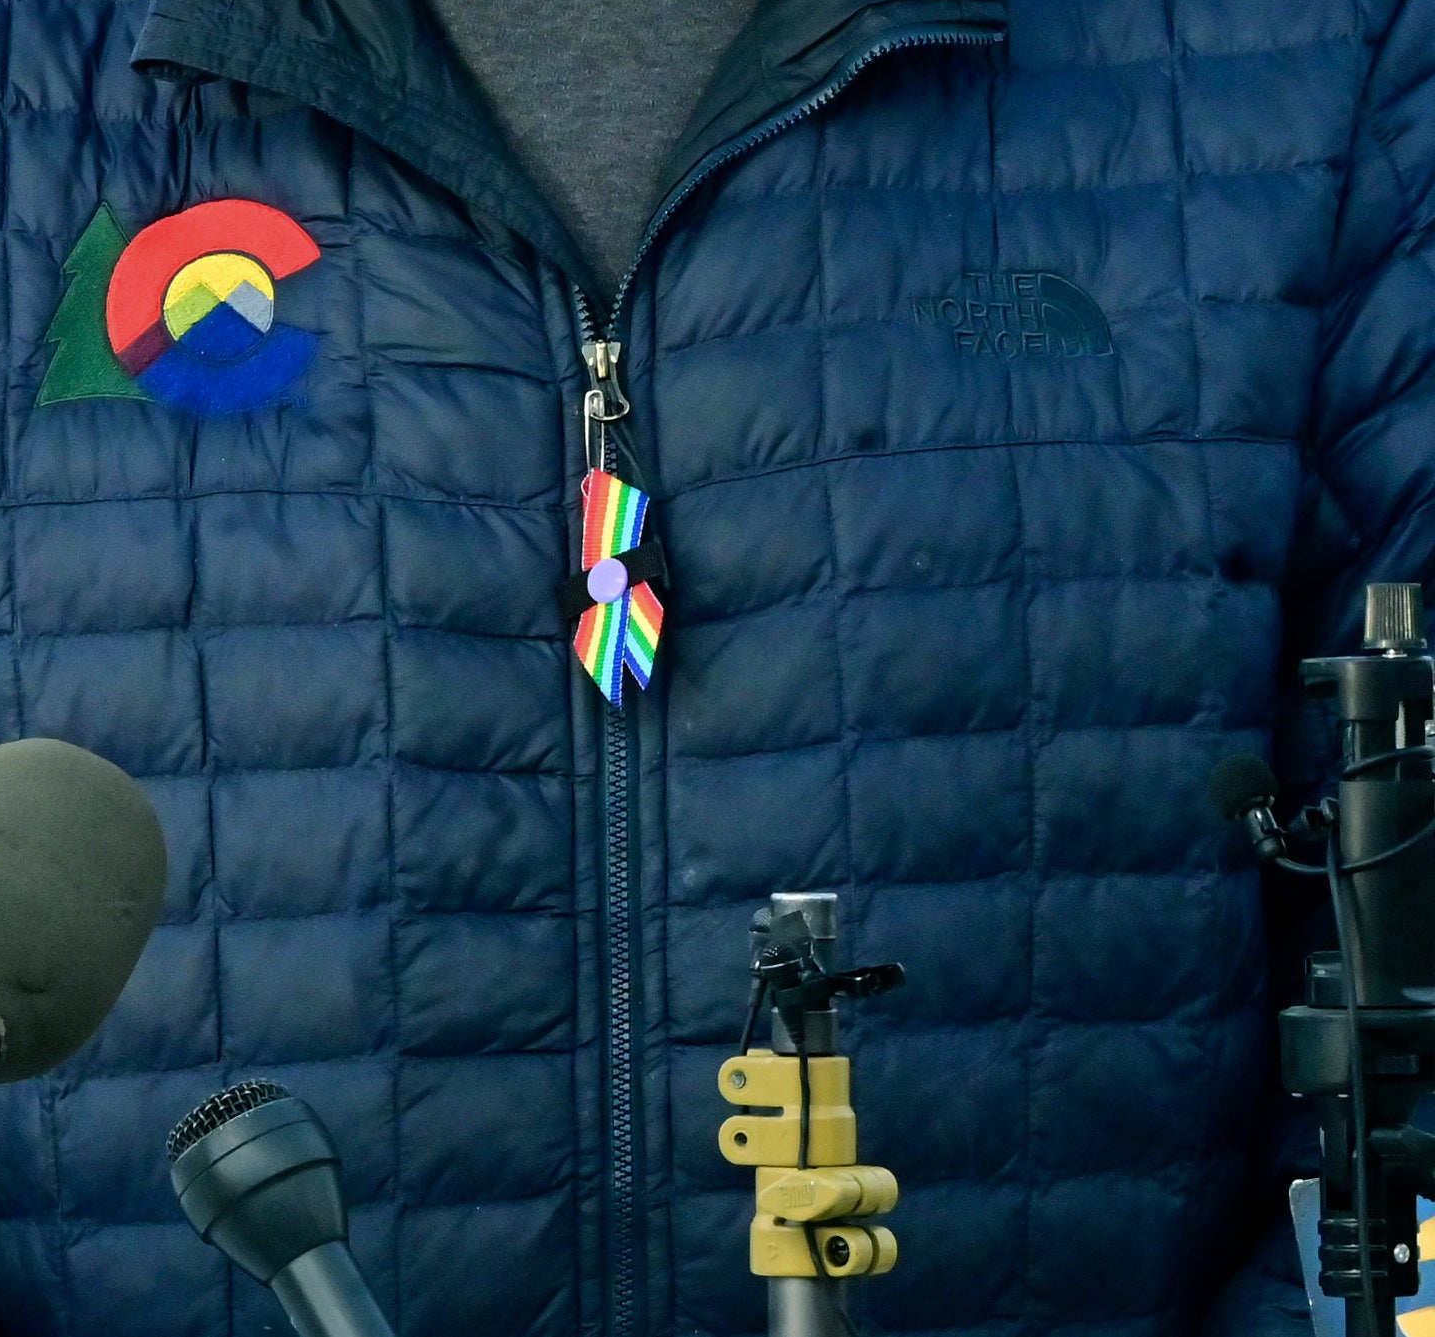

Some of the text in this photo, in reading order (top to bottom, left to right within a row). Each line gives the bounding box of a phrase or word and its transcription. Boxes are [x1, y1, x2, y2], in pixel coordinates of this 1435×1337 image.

[965, 272, 1038, 298] THE
[910, 296, 1038, 326] NORTH
[954, 327, 1044, 359] FACE
